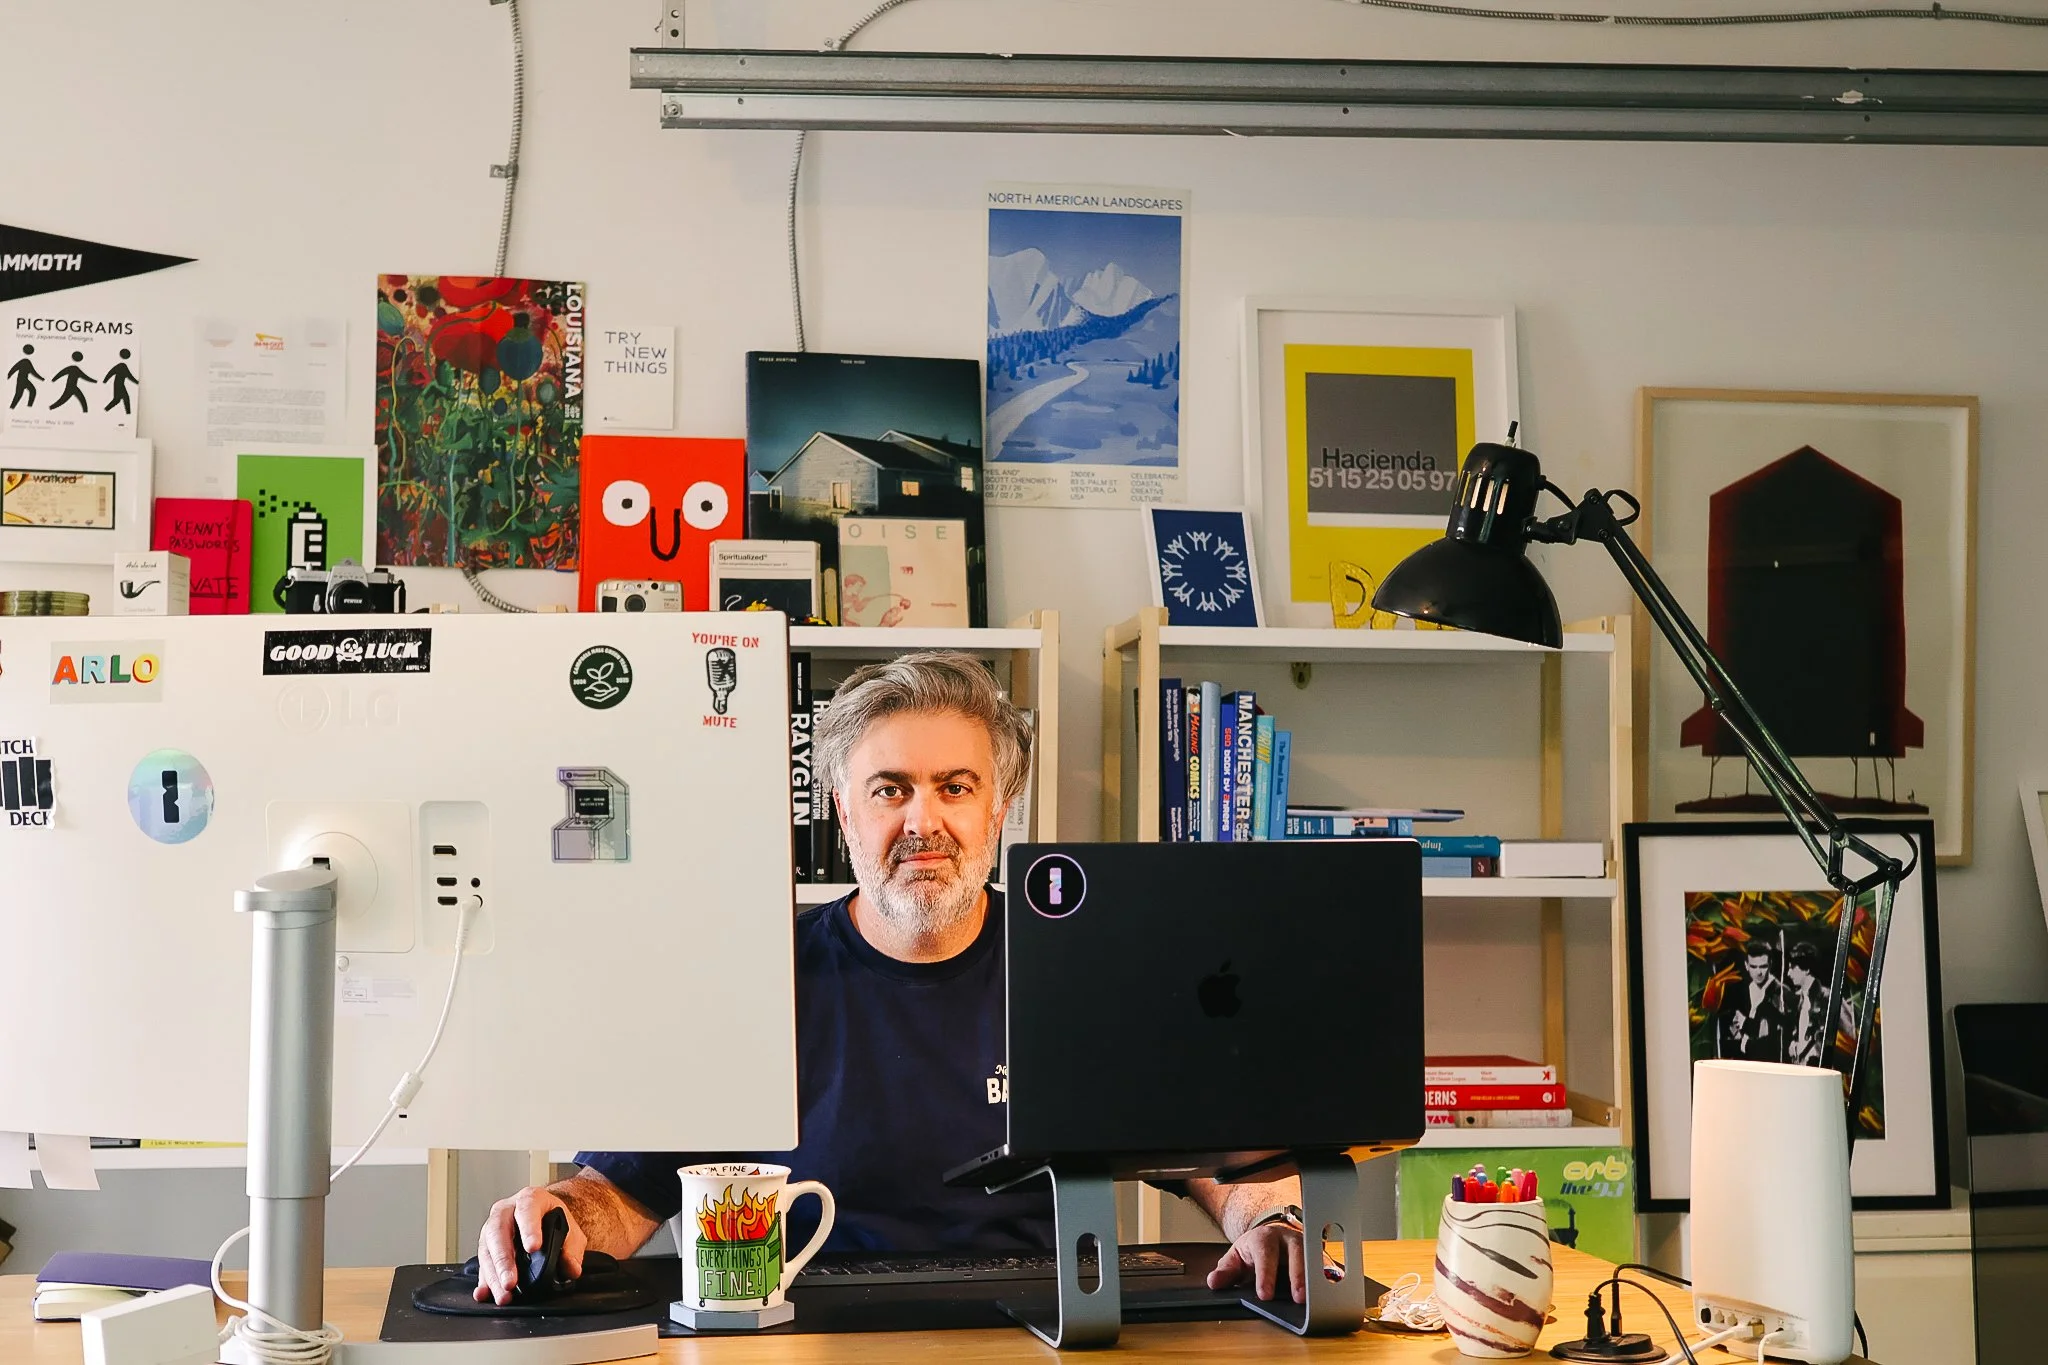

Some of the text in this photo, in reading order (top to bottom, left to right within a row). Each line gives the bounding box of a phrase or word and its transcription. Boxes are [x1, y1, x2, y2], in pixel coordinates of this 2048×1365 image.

[988, 192, 1184, 211] NORTH AMERICAN LANDSCAPES
[16, 317, 133, 335] PICTOGRAMS
[604, 331, 642, 344] TRY
[564, 284, 582, 399] LOUISIANA
[625, 346, 667, 359] NEW
[604, 360, 668, 374] THINGS
[1322, 448, 1436, 474] Haçienda
[1365, 469, 1394, 490] 25
[1397, 470, 1426, 491] 05
[1430, 471, 1457, 492] 97
[190, 577, 238, 594] VATE
[270, 641, 422, 662] GOOD LUCK
[692, 632, 760, 648] YOU'RE ON
[52, 652, 160, 685] ARLO
[702, 715, 738, 729] MUTE
[1190, 714, 1200, 754] MAKING
[0, 740, 34, 754] TCH
[1236, 695, 1253, 819] MANCHESTER
[791, 713, 810, 826] RAYGUN
[1190, 756, 1200, 800] COMICS
[813, 783, 821, 820] STANTON
[1563, 1155, 1628, 1182] orb
[703, 1268, 763, 1297] FINE!
